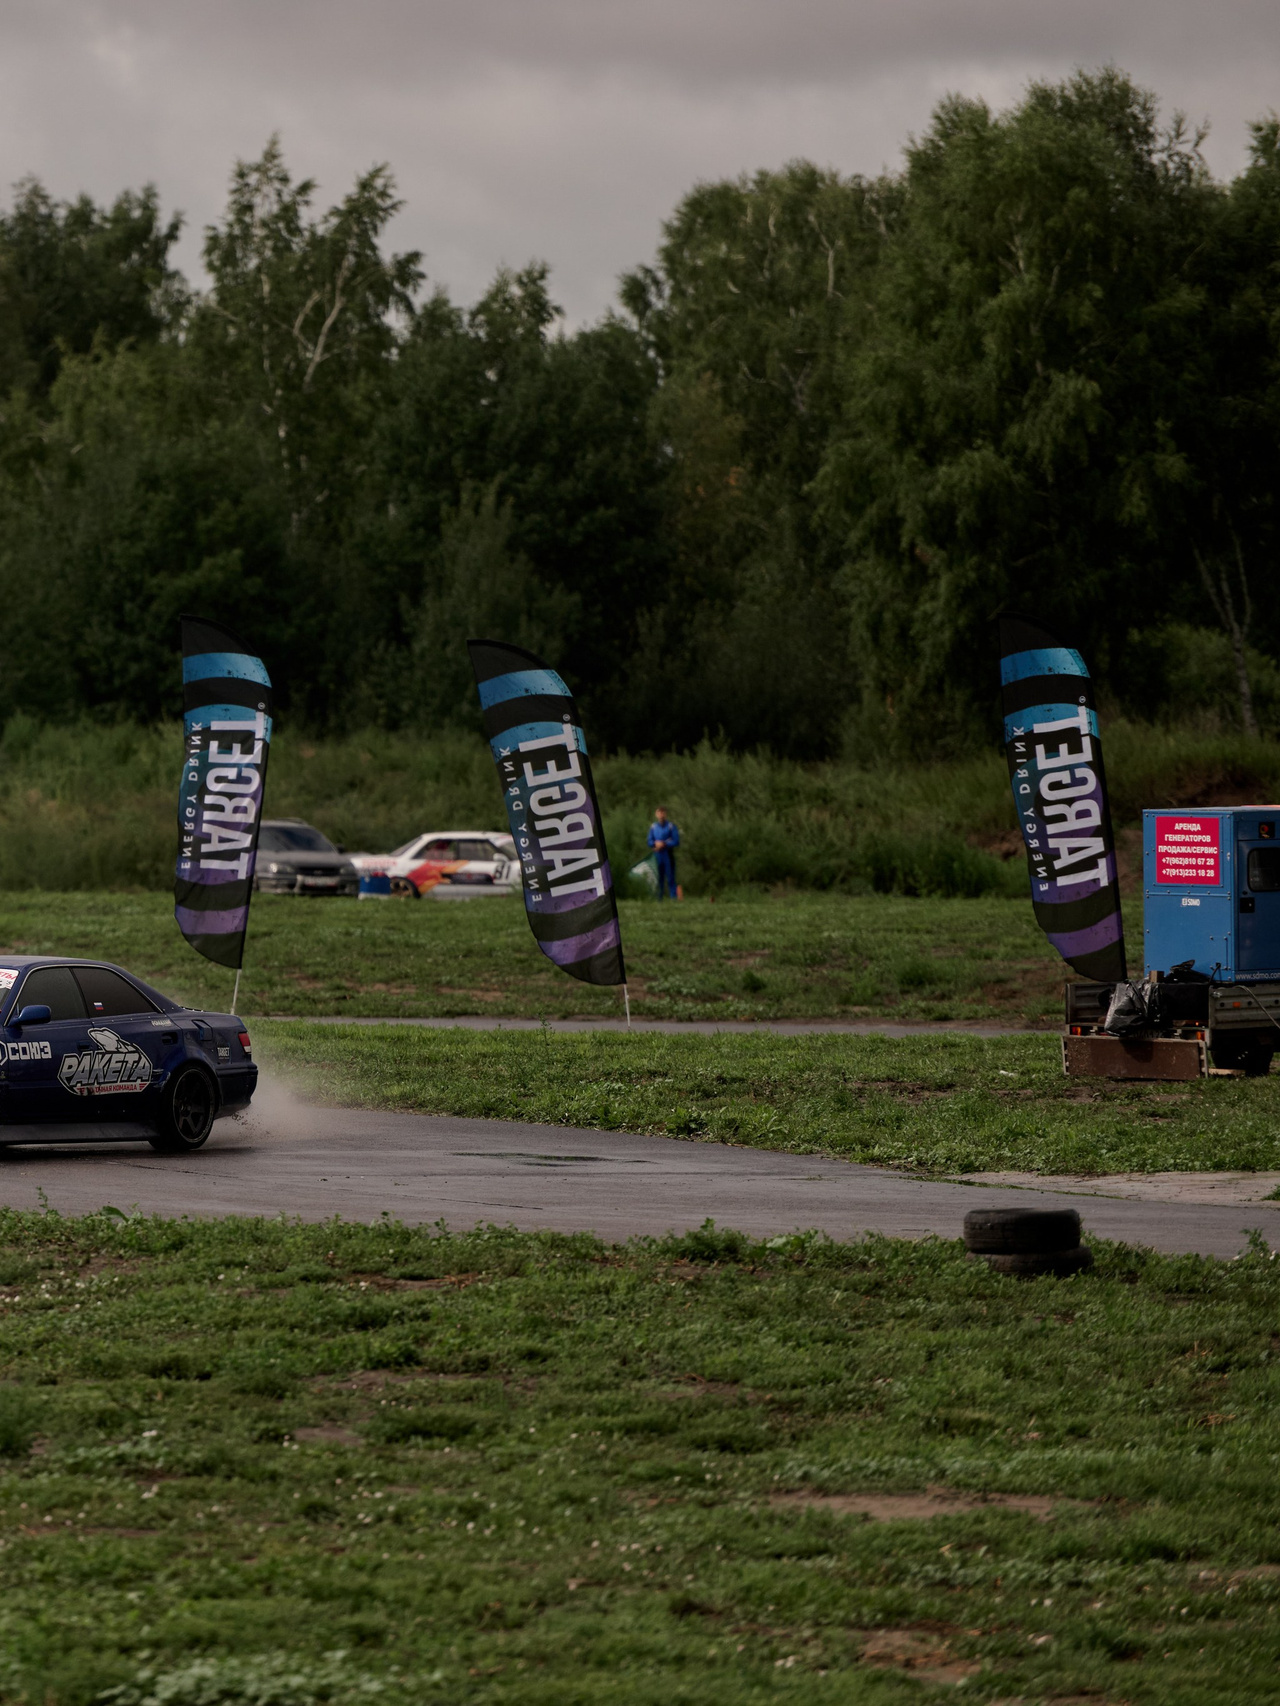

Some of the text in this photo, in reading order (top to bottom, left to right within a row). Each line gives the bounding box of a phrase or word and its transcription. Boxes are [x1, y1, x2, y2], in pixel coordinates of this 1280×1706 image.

[1174, 823, 1201, 831] АРЕНДА
[1164, 834, 1211, 842] ГЕНЕРАТОРОВ
[1158, 845, 1218, 854] ПРОДАЖА/СЕРВИС
[1206, 869, 1215, 877] 28
[7, 1041, 52, 1060] СОЮЗ
[59, 1052, 151, 1086] РАКЕТА
[113, 1083, 138, 1092] КОМАНДА
